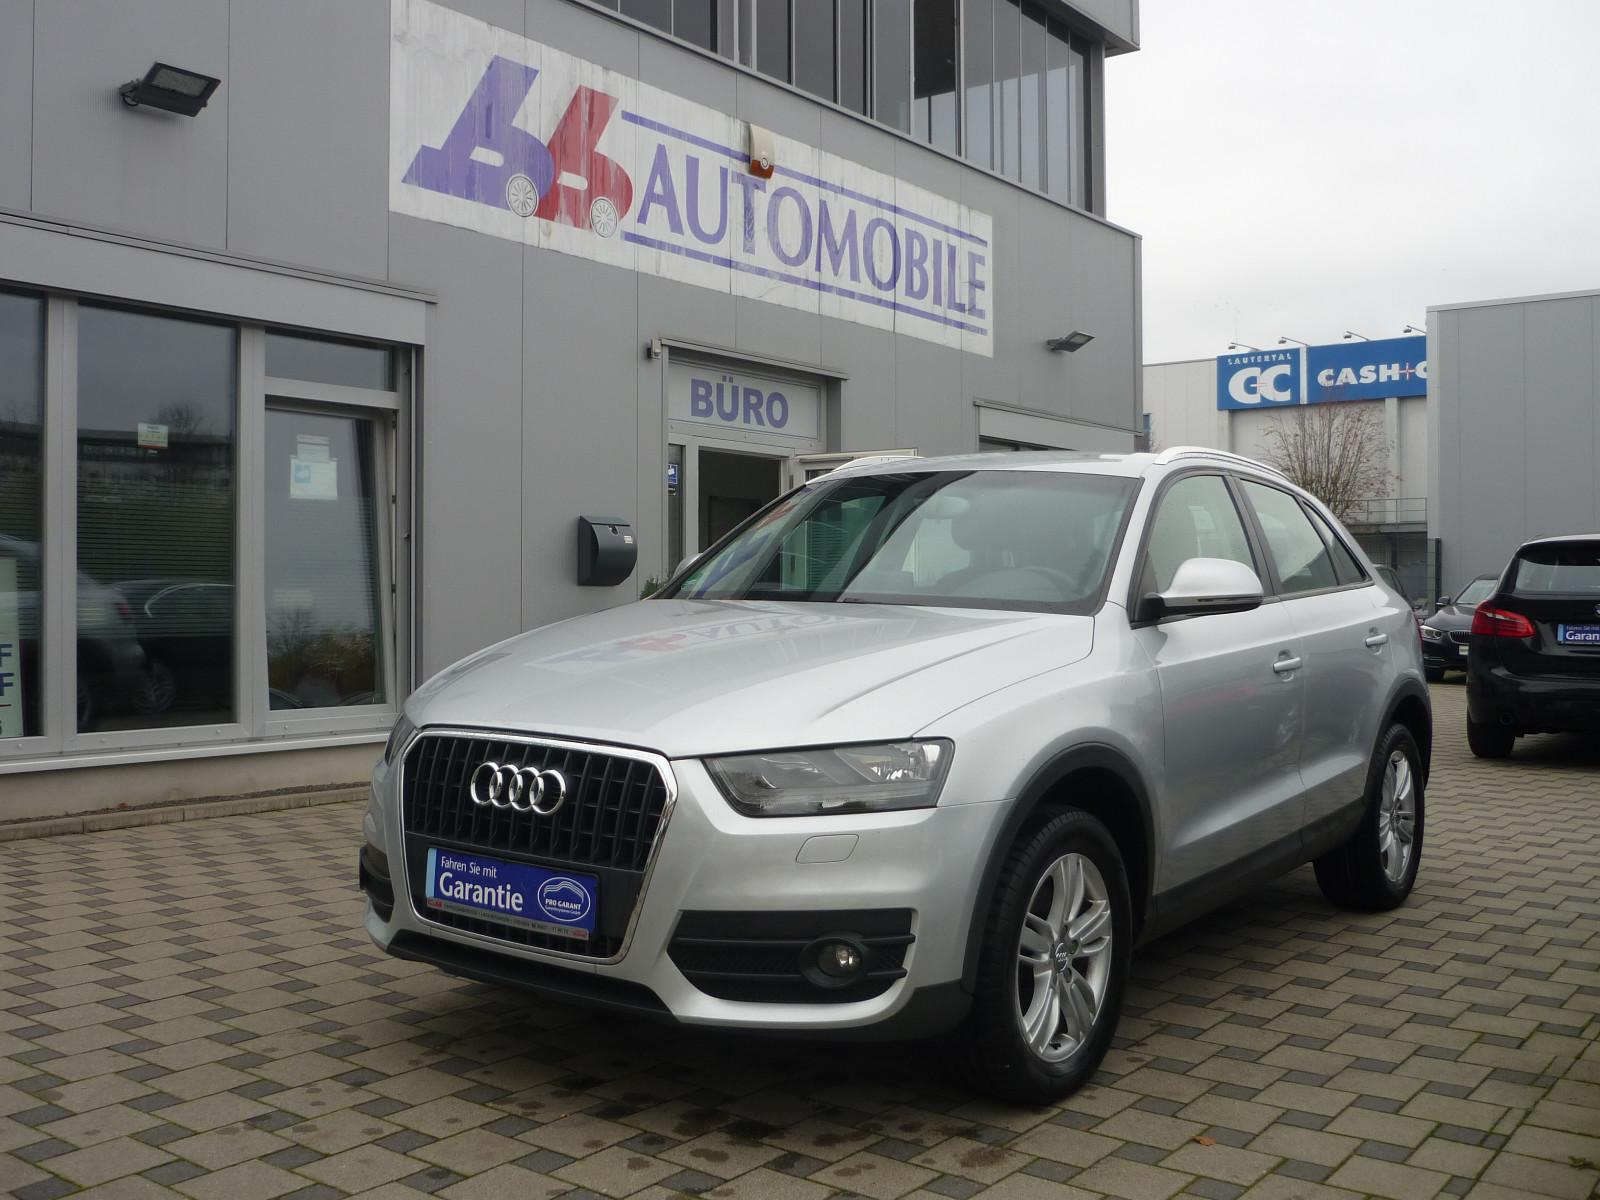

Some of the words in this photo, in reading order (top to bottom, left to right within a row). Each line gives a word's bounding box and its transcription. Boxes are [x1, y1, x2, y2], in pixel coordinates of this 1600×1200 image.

[637, 143, 987, 320] AUTOMOBILE
[1227, 353, 1292, 365] LAUTERTAL
[690, 375, 789, 429] BÜRO
[441, 856, 467, 872] Fahren
[469, 861, 480, 875] Sie
[482, 865, 497, 878] mit
[439, 871, 524, 912] Garantie
[545, 898, 557, 906] PRO
[558, 900, 581, 910] GARANT
